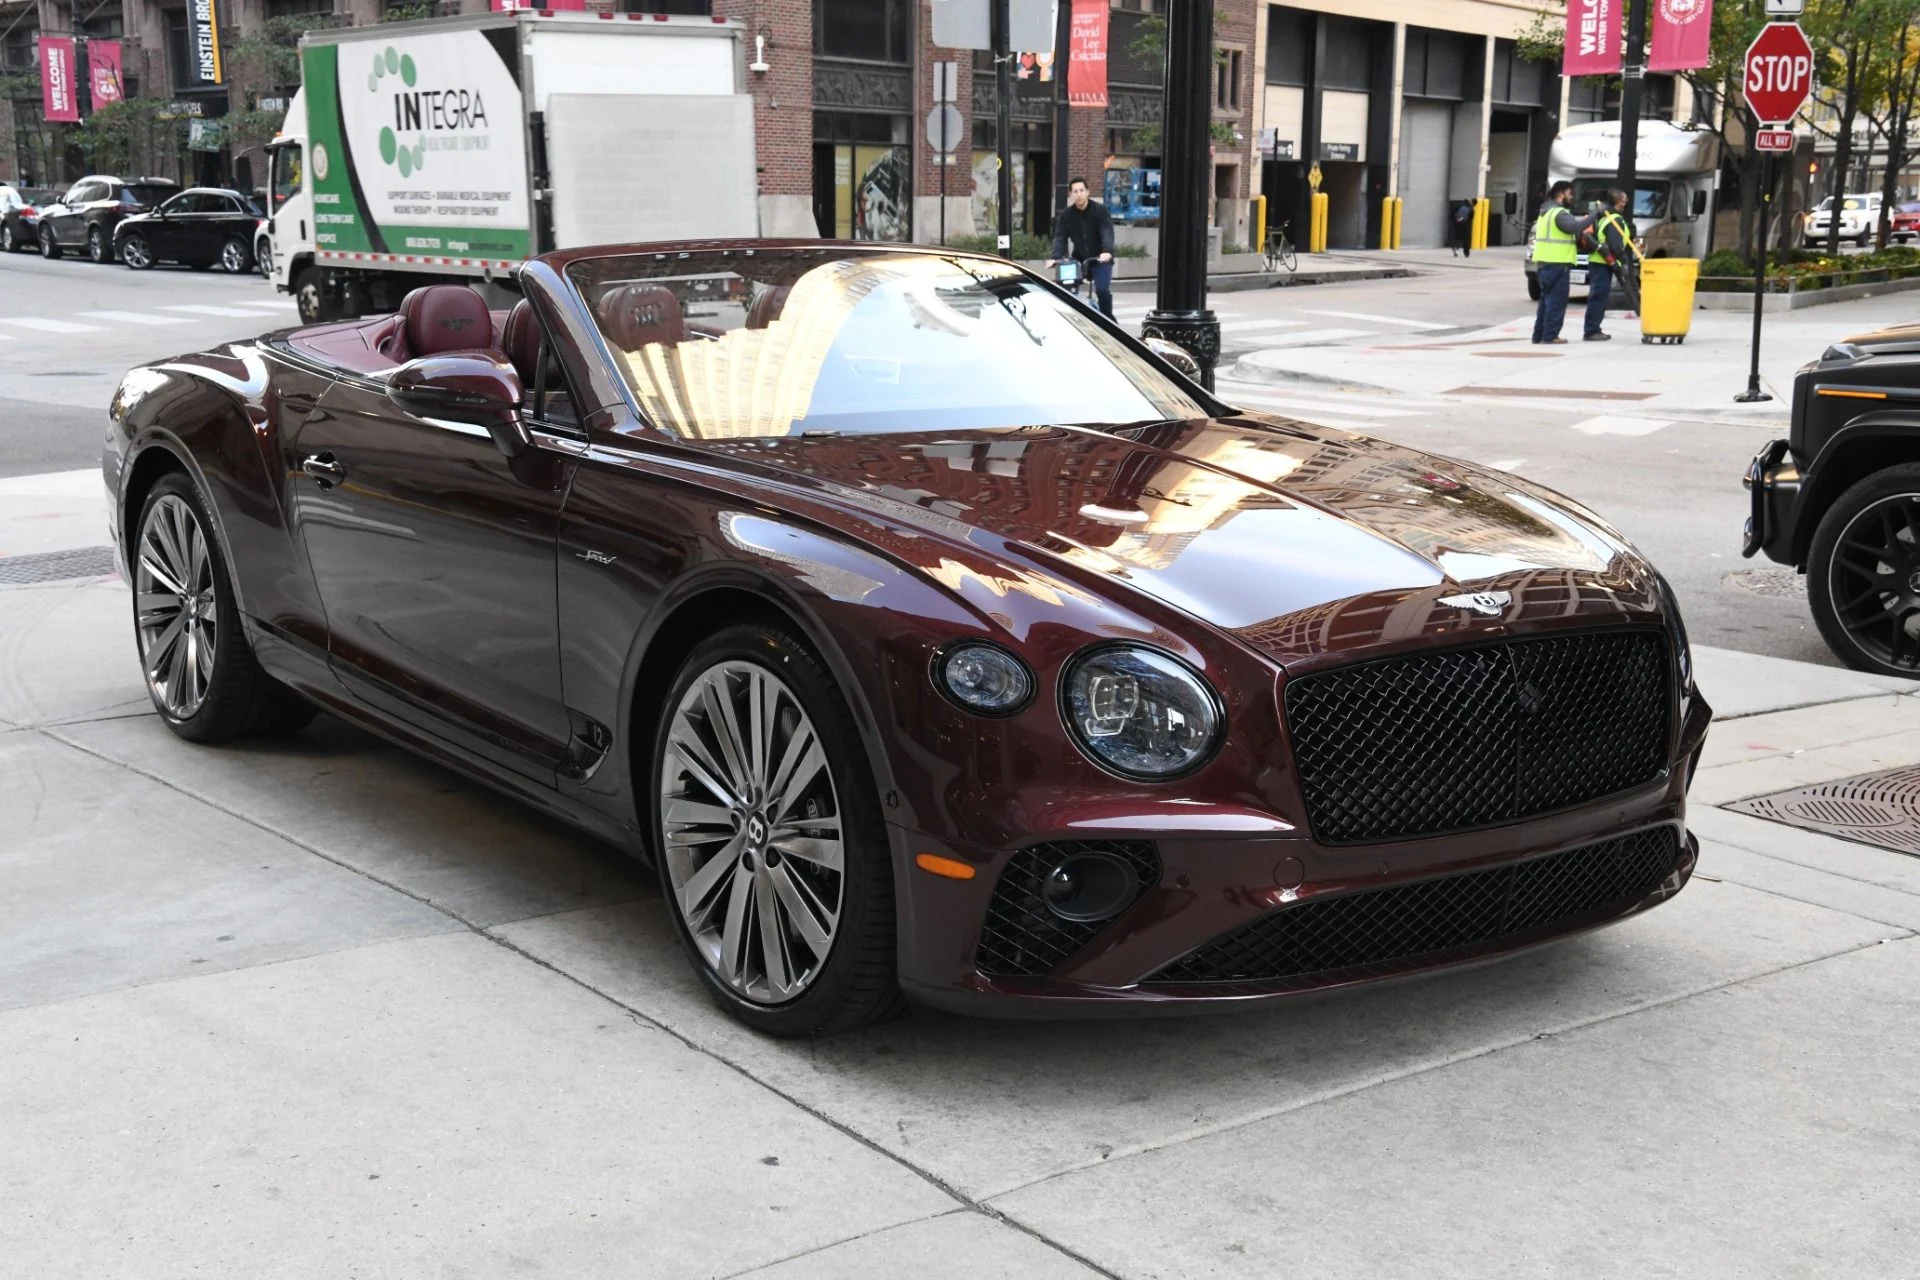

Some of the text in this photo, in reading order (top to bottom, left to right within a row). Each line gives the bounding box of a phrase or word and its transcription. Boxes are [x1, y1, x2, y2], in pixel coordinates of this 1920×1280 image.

[1073, 26, 1100, 38] David
[1083, 38, 1100, 49] Lee
[1597, 20, 1608, 55] WATER
[197, 23, 215, 81] EINSTEIN
[48, 47, 62, 111] WELCOME
[1749, 55, 1809, 92] STOP
[1068, 92, 1106, 103] LUMA
[394, 88, 489, 131] INTEGRA
[1760, 134, 1790, 146] ALL WAY
[1587, 148, 1612, 159] The
